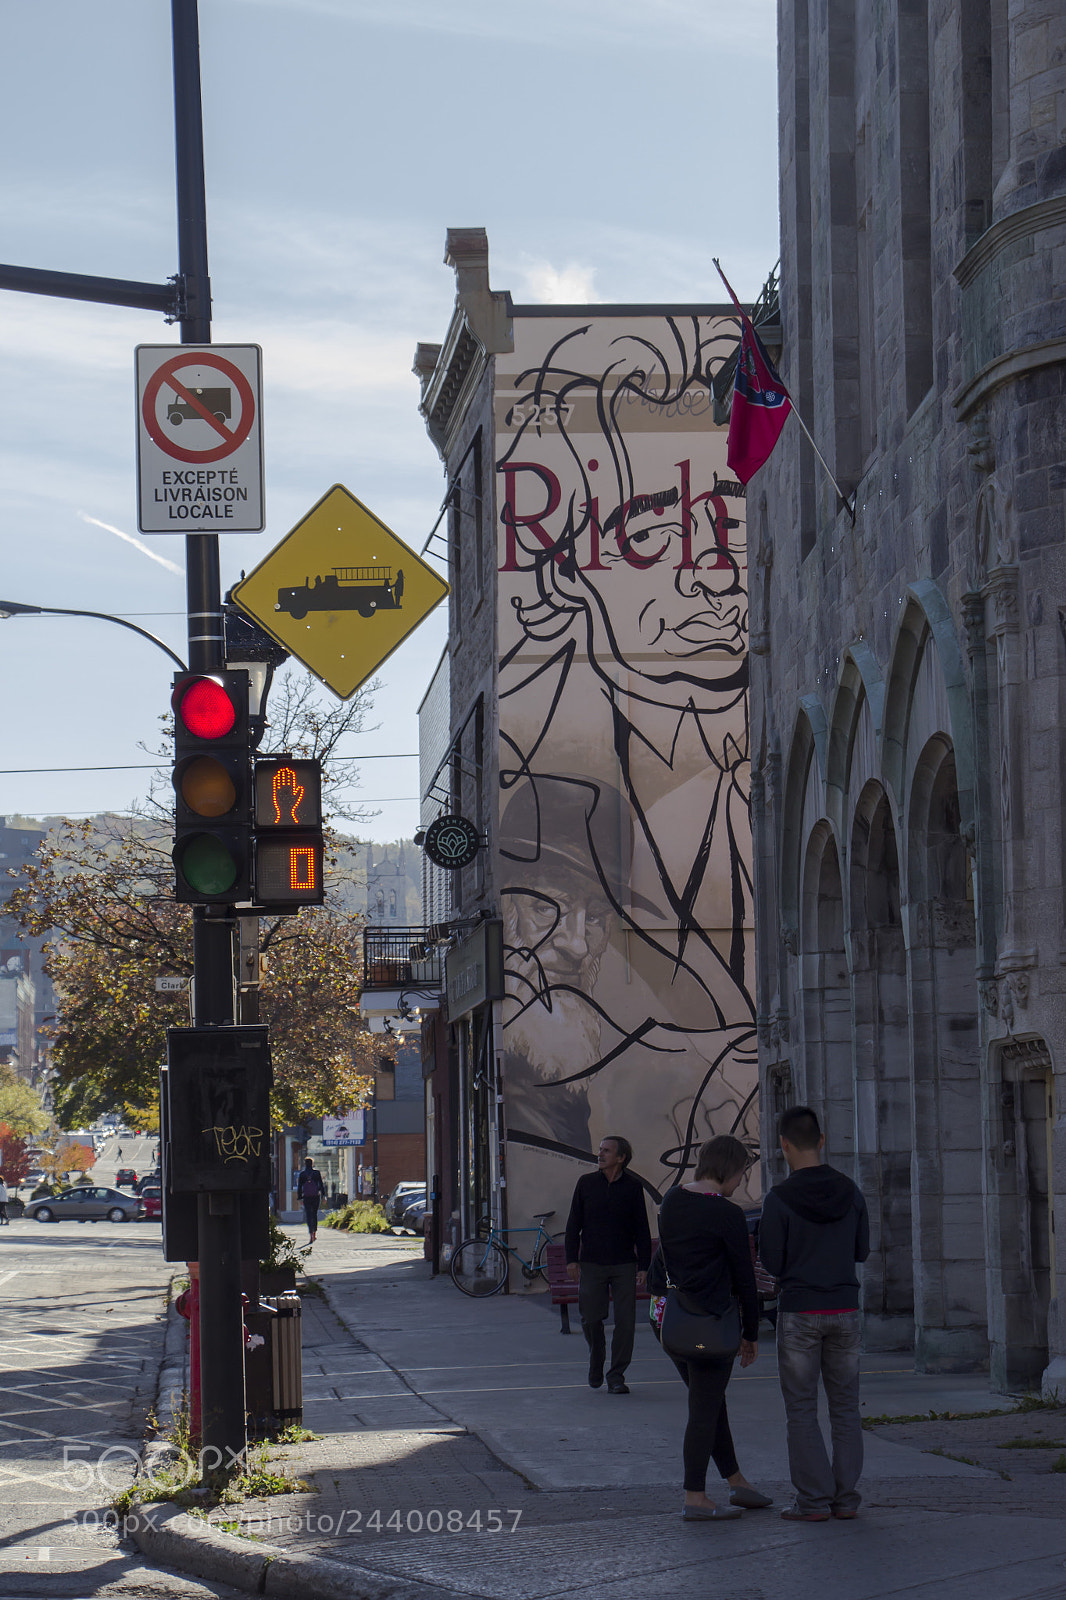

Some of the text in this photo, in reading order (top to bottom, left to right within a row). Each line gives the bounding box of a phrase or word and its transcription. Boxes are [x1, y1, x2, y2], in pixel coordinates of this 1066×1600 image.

[511, 404, 576, 426] 5257
[162, 468, 239, 485] EXCEPTÉ
[154, 487, 248, 502] LIVRAISON
[168, 504, 234, 519] LOCALE
[498, 459, 747, 572] Rich
[290, 847, 315, 889] 0
